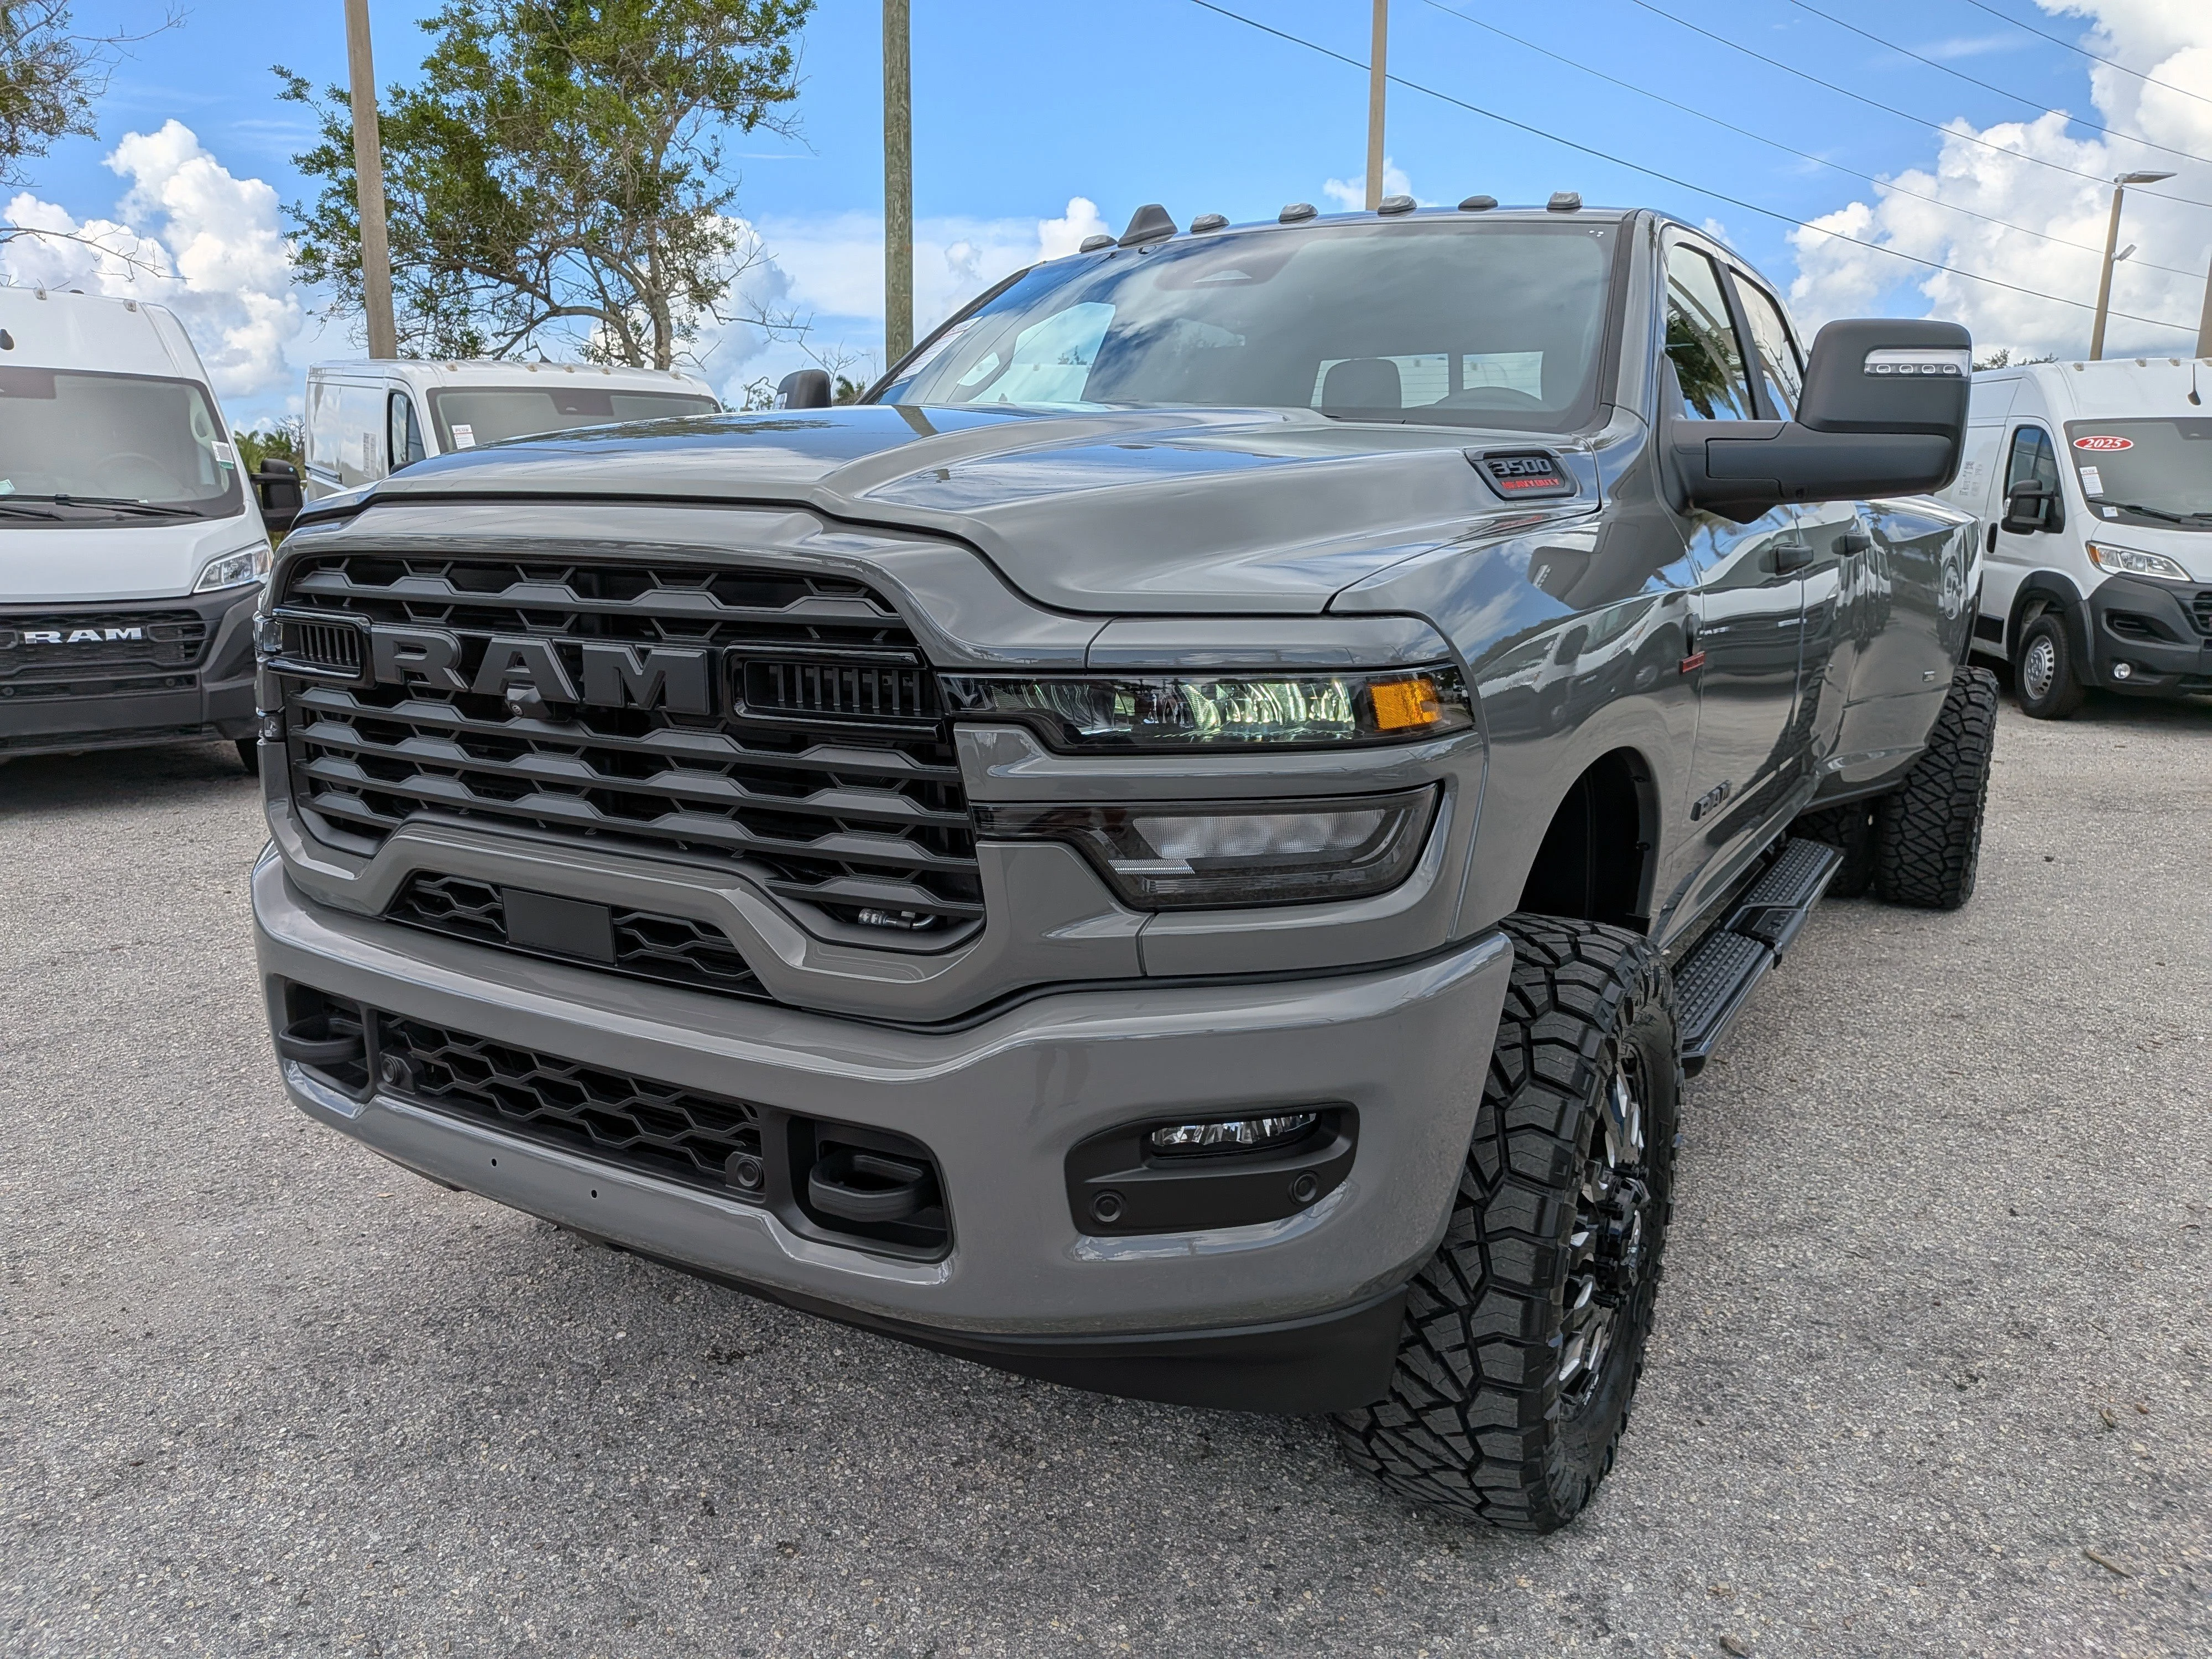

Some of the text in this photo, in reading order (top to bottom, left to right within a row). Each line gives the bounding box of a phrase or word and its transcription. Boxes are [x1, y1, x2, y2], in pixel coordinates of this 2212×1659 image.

[2083, 439, 2123, 448] 2025
[1490, 458, 1552, 476] 3500
[24, 627, 142, 644] RAM
[371, 624, 711, 716] RAM
